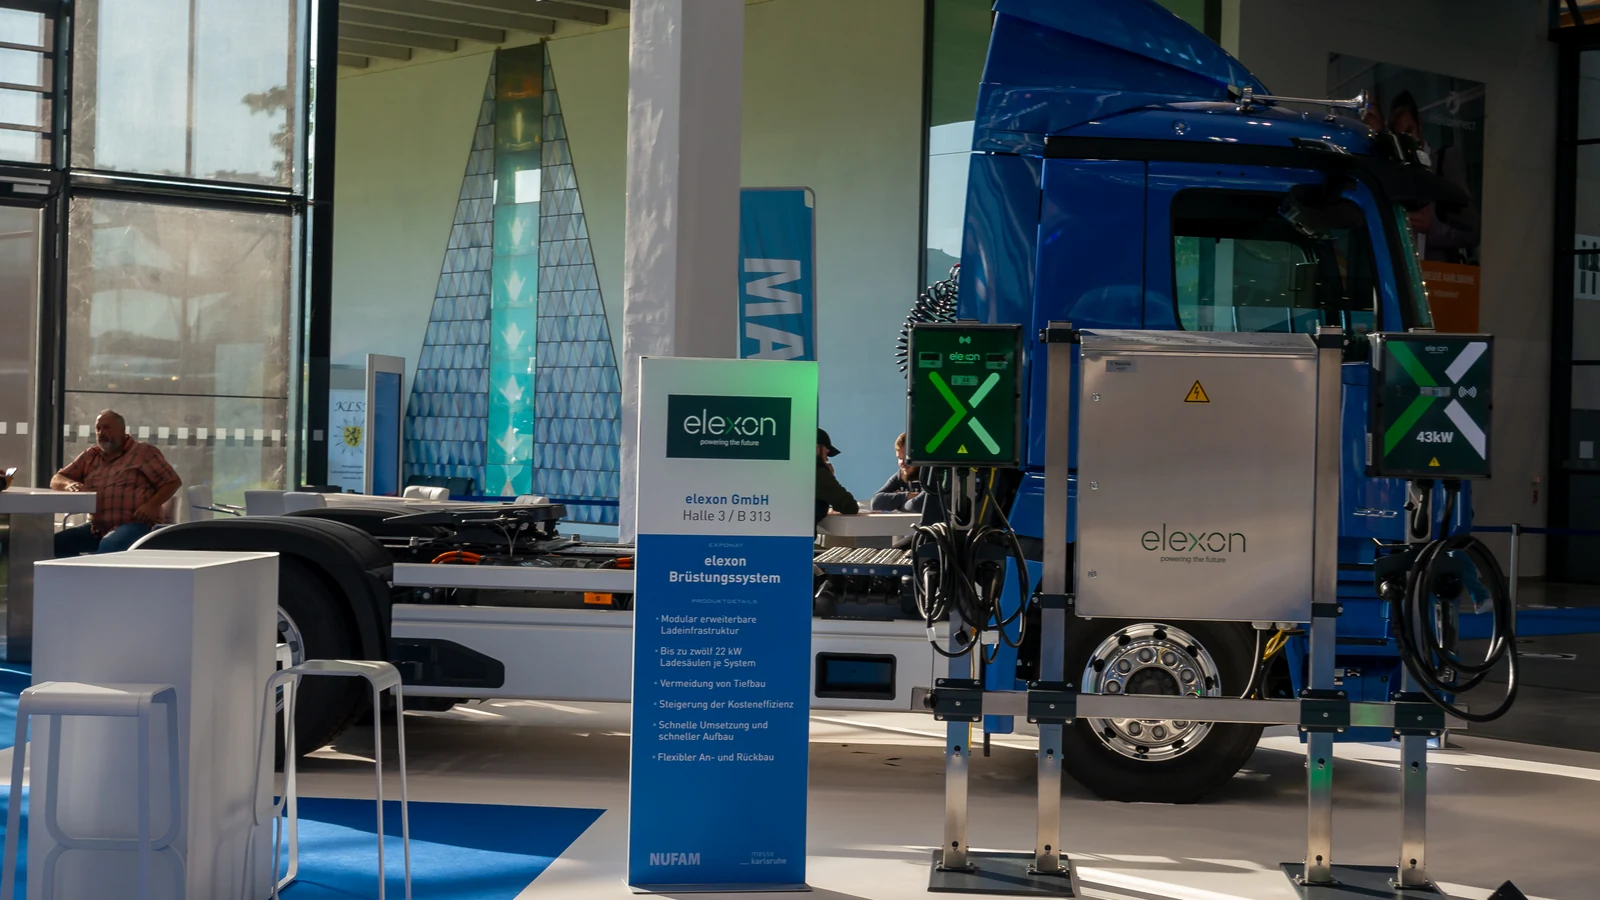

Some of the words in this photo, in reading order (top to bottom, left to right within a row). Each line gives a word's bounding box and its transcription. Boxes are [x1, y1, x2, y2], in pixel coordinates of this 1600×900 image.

[683, 408, 777, 436] elexon
[1416, 431, 1454, 443] 43kW
[700, 439, 728, 447] powering
[685, 493, 727, 505] elexon
[731, 494, 769, 506] GmbH
[683, 509, 715, 521] Halle
[718, 510, 726, 522] 3
[737, 511, 746, 522] B
[750, 511, 771, 522] 313
[1141, 522, 1246, 552] elexon
[704, 554, 746, 567] elexon
[1160, 555, 1191, 564] powering
[1206, 556, 1226, 564] future
[669, 571, 781, 585] Brüstungssystem
[661, 615, 698, 623] Modular
[700, 615, 757, 624] erweiterbare
[661, 626, 740, 635] Ladeinfrastruktur
[660, 647, 674, 655] Bis
[689, 647, 713, 656] zwölf
[715, 647, 726, 656] 22
[728, 647, 742, 656] kW
[660, 659, 711, 668] Ladesäulen
[713, 659, 722, 669] je
[723, 659, 756, 669] System
[660, 679, 713, 690] Vermeidung
[734, 679, 766, 688] Tiefbau
[659, 700, 708, 710] Steigerung
[710, 700, 725, 709] der
[728, 700, 794, 709] Kosteneffizienz
[658, 720, 697, 729] Schnelle
[700, 721, 749, 731] Umsetzung
[751, 721, 768, 729] und
[658, 732, 700, 741] schneller
[702, 732, 734, 741] Aufbau
[657, 752, 696, 761] Flexibler
[699, 753, 715, 761] An-
[717, 753, 734, 761] und
[736, 752, 774, 762] Rückbau
[650, 852, 700, 866] NUFAM
[751, 857, 787, 865] karlsruhe
